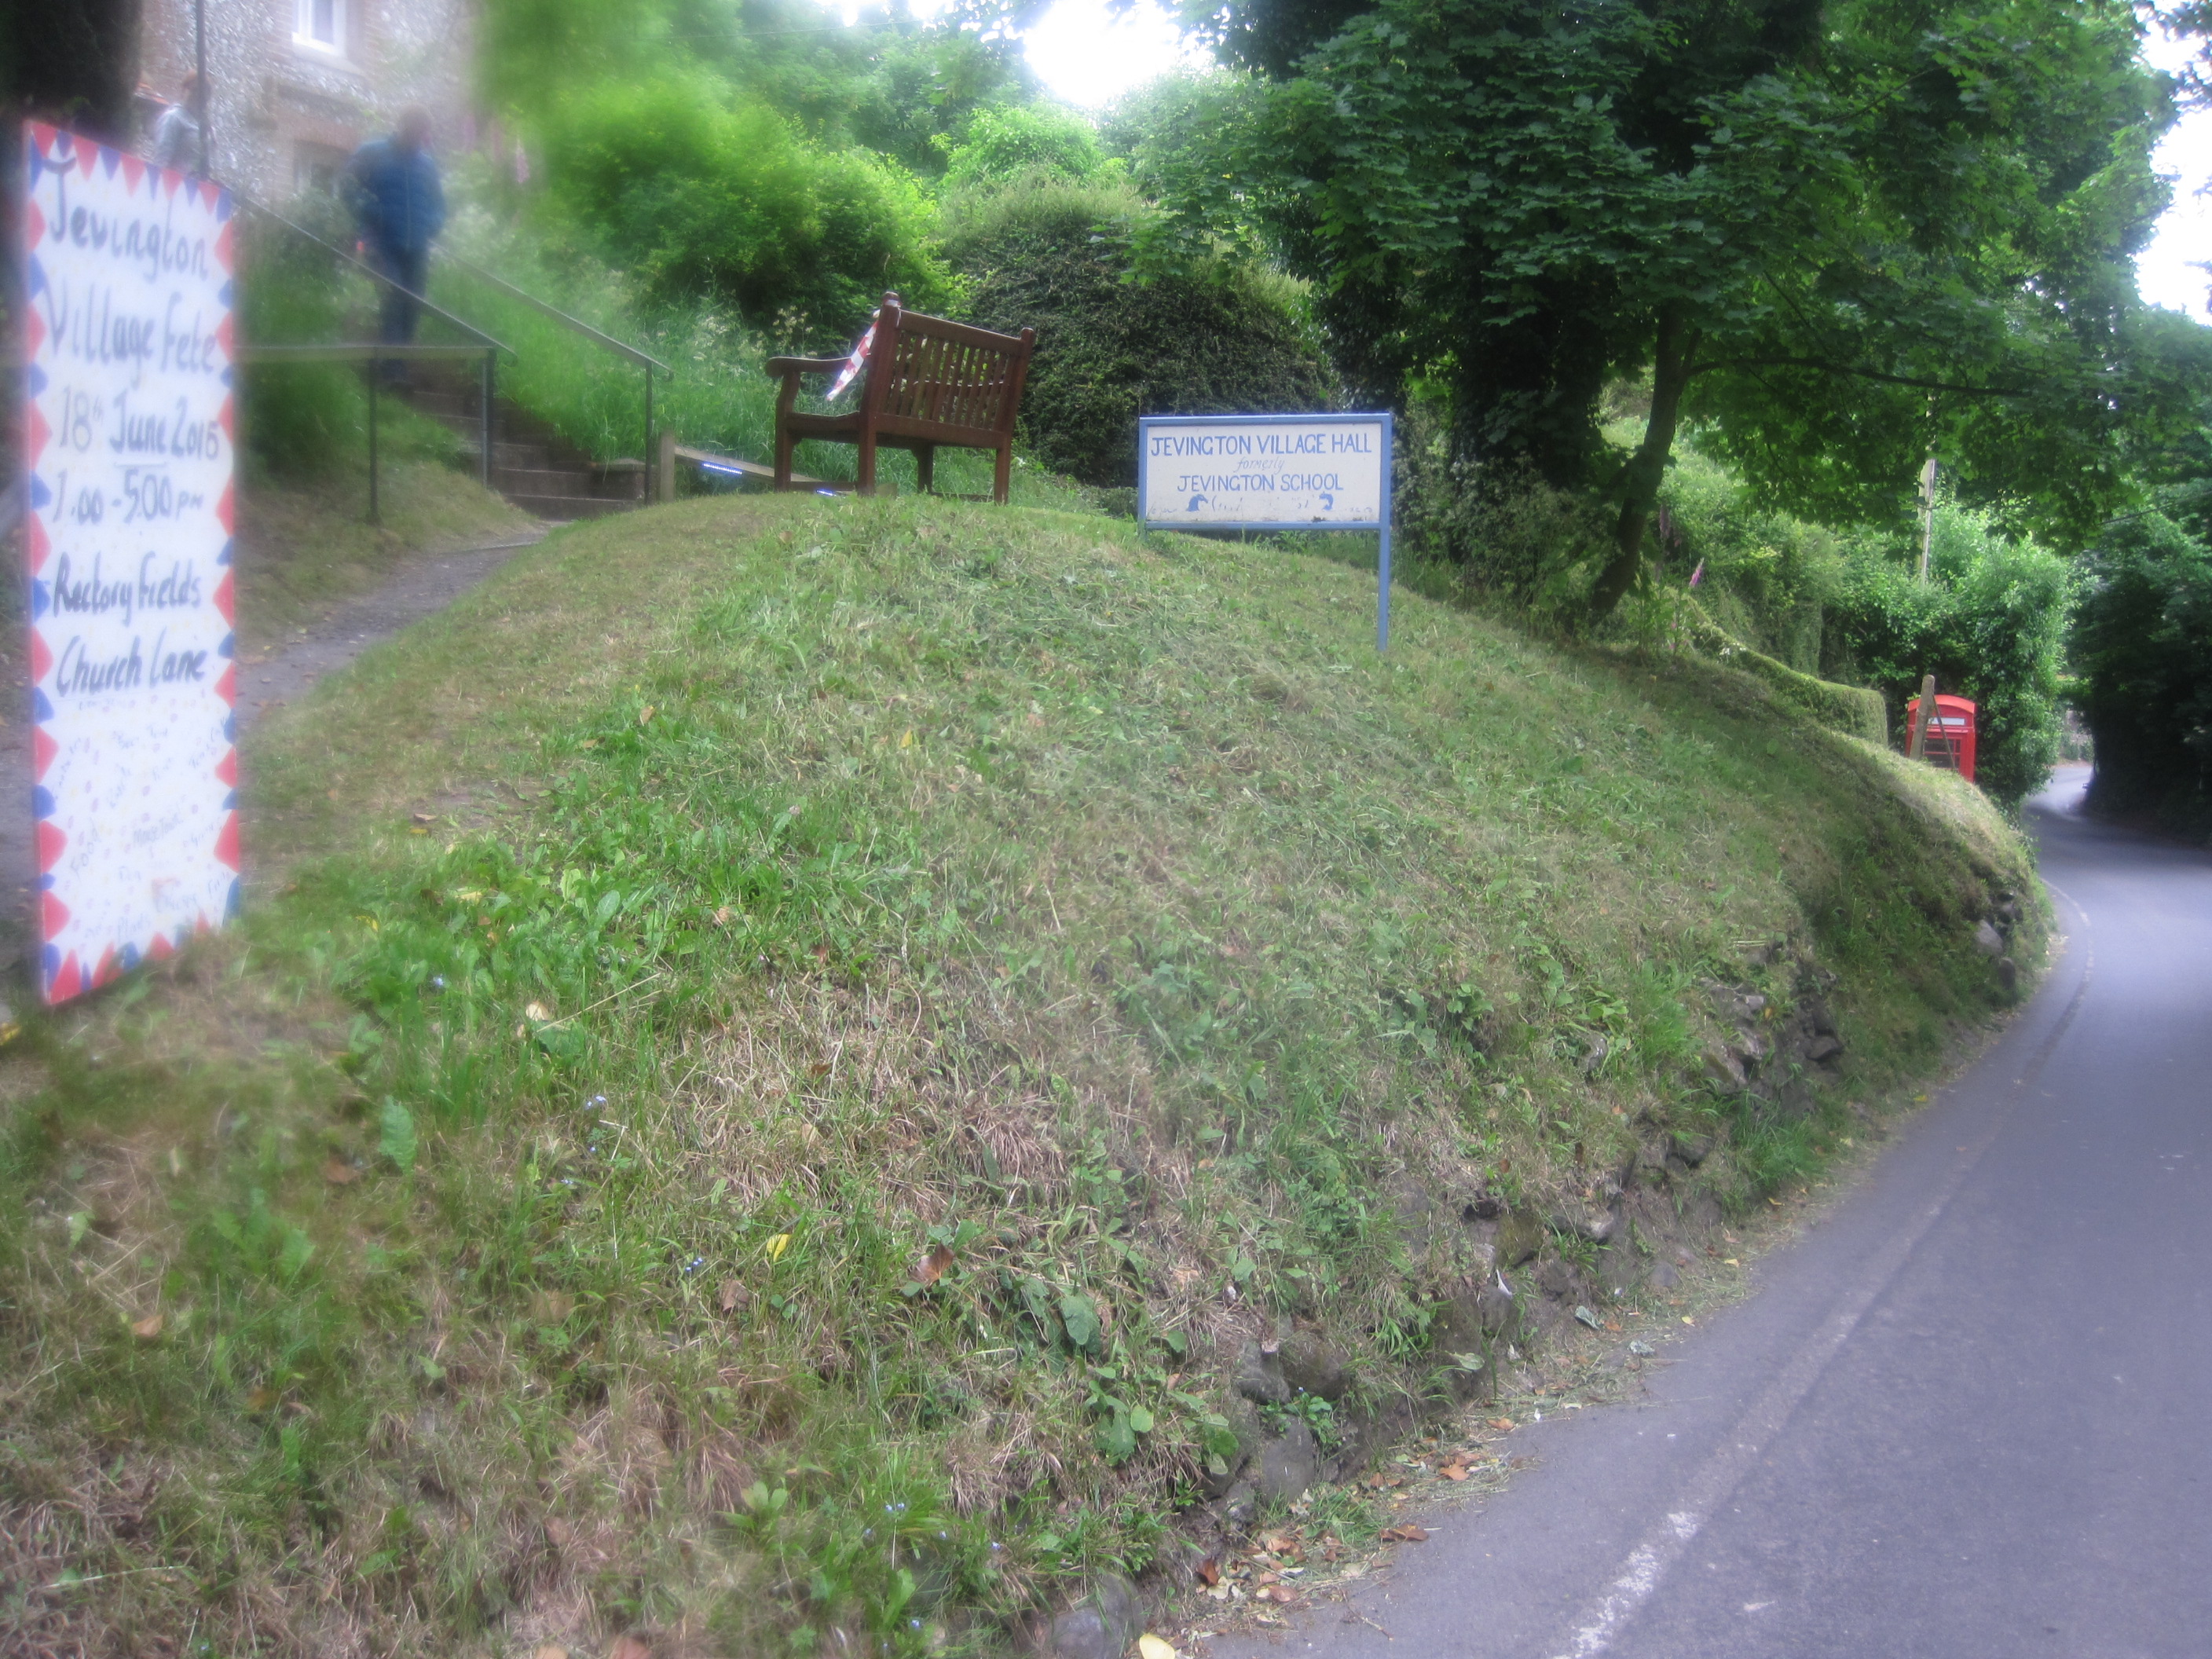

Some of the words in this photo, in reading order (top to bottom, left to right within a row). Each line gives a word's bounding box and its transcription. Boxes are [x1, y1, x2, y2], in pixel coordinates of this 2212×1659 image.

[43, 157, 208, 284] Jevington
[45, 276, 154, 390] Village
[110, 389, 167, 455] June
[1151, 435, 1251, 456] JEVINGTON
[1257, 434, 1326, 455] VILLAGE
[1331, 433, 1372, 453] HALL
[1177, 474, 1274, 492] JEVINGTON
[1280, 474, 1343, 491] SCHOOL
[1233, 456, 1285, 475] formerly
[53, 551, 132, 627] Rectory
[138, 551, 202, 610] Fields
[57, 635, 142, 698] Church
[149, 626, 208, 689] Lane
